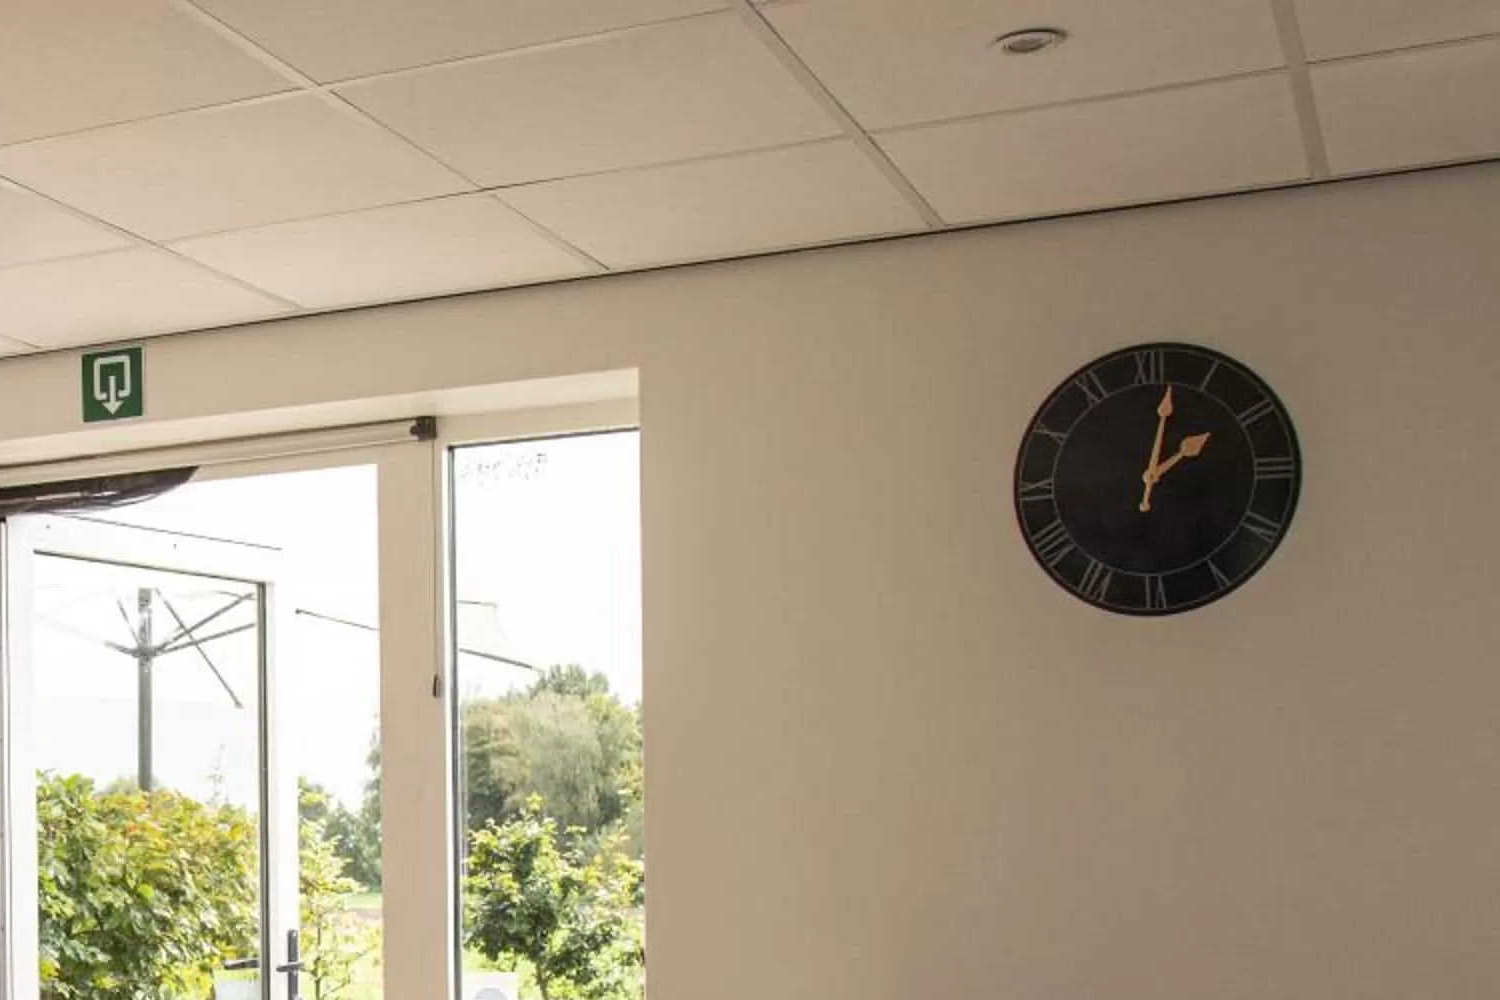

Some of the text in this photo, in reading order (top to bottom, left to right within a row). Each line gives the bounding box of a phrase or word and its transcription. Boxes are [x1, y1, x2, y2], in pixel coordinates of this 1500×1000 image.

[1131, 350, 1164, 384] XII
[1075, 370, 1109, 407] XI
[1236, 398, 1275, 429] II
[1033, 423, 1068, 445] X
[1254, 457, 1294, 480] III
[1020, 477, 1055, 500] IX
[1030, 517, 1076, 568] VIII
[1240, 511, 1281, 543] IV
[1079, 558, 1114, 602] VII
[1207, 559, 1232, 590] V
[1144, 574, 1167, 609] VI
